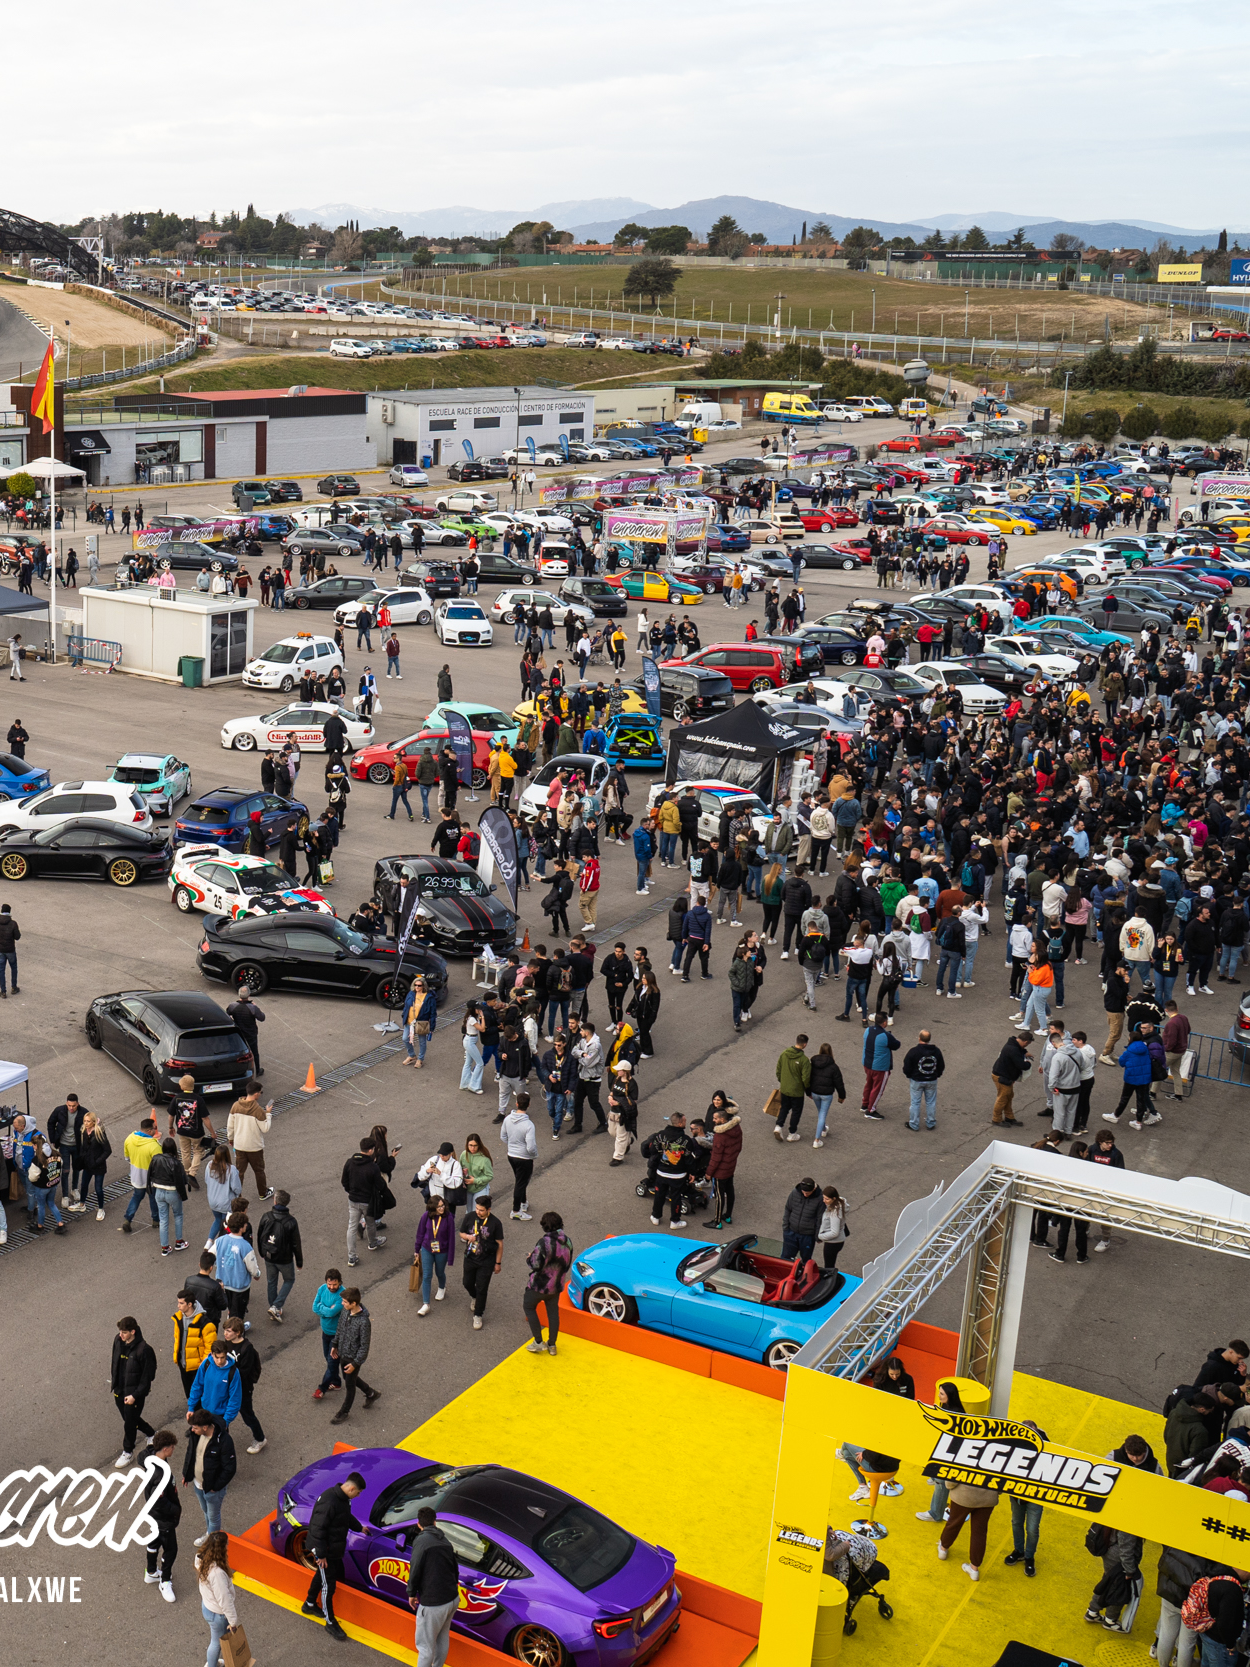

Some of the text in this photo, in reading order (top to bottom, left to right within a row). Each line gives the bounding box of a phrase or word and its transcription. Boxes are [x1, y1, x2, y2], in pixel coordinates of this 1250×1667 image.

[456, 408, 474, 416] RACE
[474, 407, 483, 415] DE
[483, 404, 519, 414] CONDUCCIÓN
[524, 404, 547, 412] CENTRO
[547, 403, 556, 411] DE
[555, 401, 586, 411] FORMACIÓN
[213, 893, 223, 910] 25
[951, 1415, 986, 1437] HOT
[932, 1434, 1123, 1494] LEGENDS
[936, 1466, 1088, 1508] SPAIN & PORTUGAL
[778, 1530, 824, 1548] LEGENDS
[377, 1560, 401, 1575] HOT
